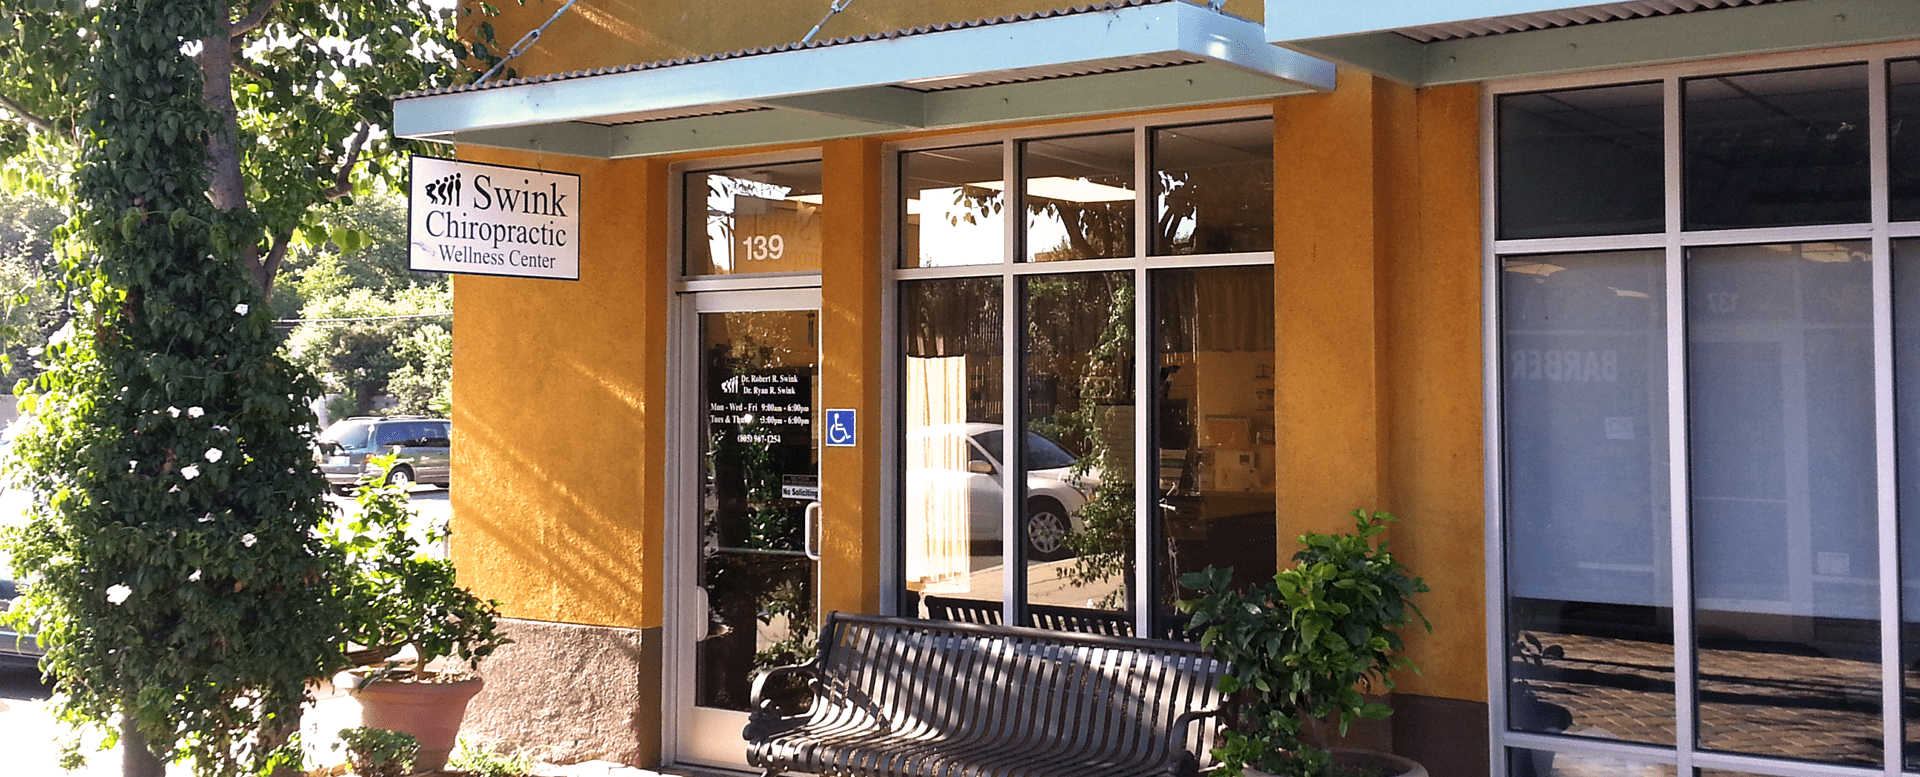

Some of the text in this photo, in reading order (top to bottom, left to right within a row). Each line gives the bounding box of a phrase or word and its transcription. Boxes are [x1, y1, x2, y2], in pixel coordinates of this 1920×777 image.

[473, 174, 568, 217] Swink
[425, 210, 567, 249] Chiropractic
[742, 234, 784, 260] 139
[438, 244, 556, 268] Wellness Center
[741, 375, 798, 383] Dr. Robert R. Swink
[743, 387, 796, 396] Dr. Ryan R. Swink
[710, 403, 725, 412] Mon
[729, 403, 743, 412] Wed
[748, 403, 758, 412] Fri
[710, 415, 724, 423] Tues
[783, 487, 791, 496] No
